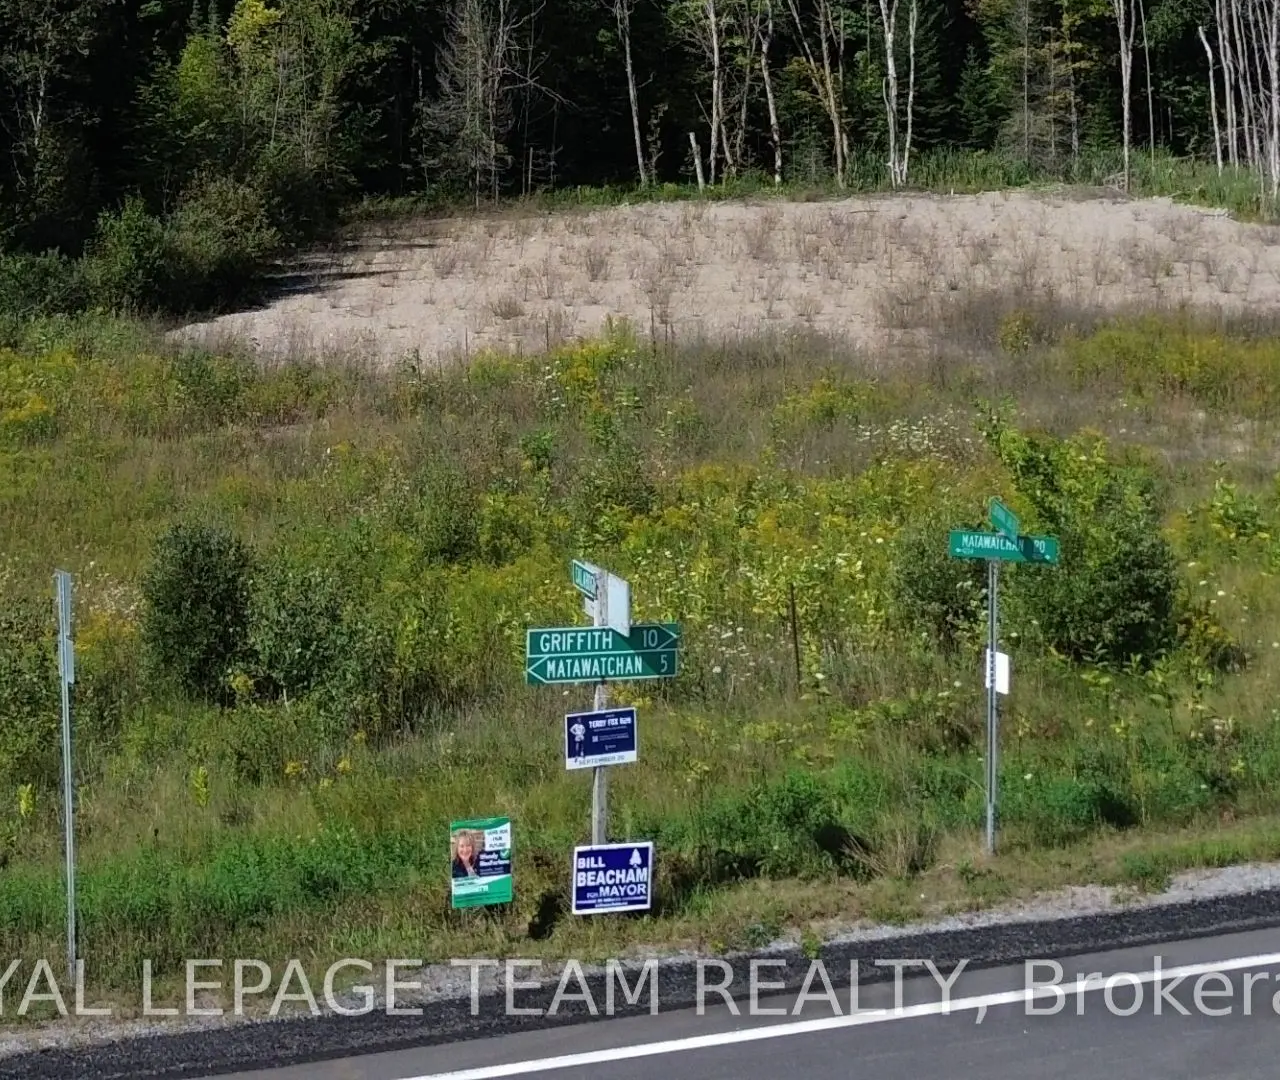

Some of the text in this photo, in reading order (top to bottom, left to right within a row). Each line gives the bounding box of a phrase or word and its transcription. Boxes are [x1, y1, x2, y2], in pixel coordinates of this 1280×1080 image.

[539, 629, 658, 652] GRIFFITH 10
[546, 654, 668, 679] MATAWATCHAN 5
[577, 855, 606, 869] BILL
[577, 867, 648, 887] BEACHAM
[599, 883, 647, 897] MAYOR
